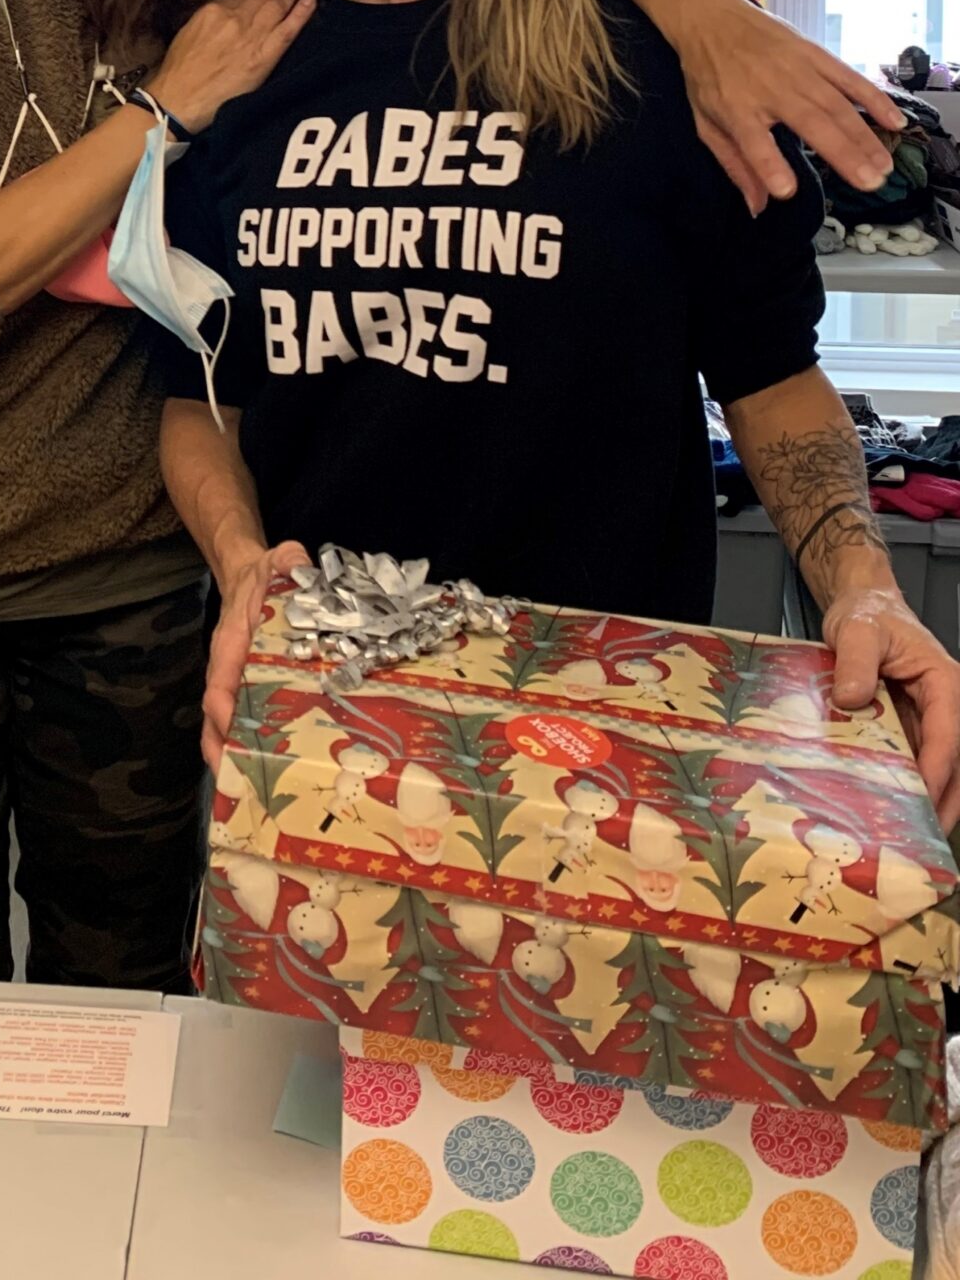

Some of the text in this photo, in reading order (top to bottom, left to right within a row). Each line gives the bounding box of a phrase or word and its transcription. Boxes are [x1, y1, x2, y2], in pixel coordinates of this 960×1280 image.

[276, 108, 527, 188] BABES
[237, 207, 564, 279] SUPPORTING
[260, 288, 509, 384] BABES.
[527, 718, 592, 764] SHOEBOX
[550, 723, 595, 755] PROJECT
[19, 1106, 44, 1114] don!
[76, 1108, 102, 1117] pour
[103, 1110, 131, 1118] Merci
